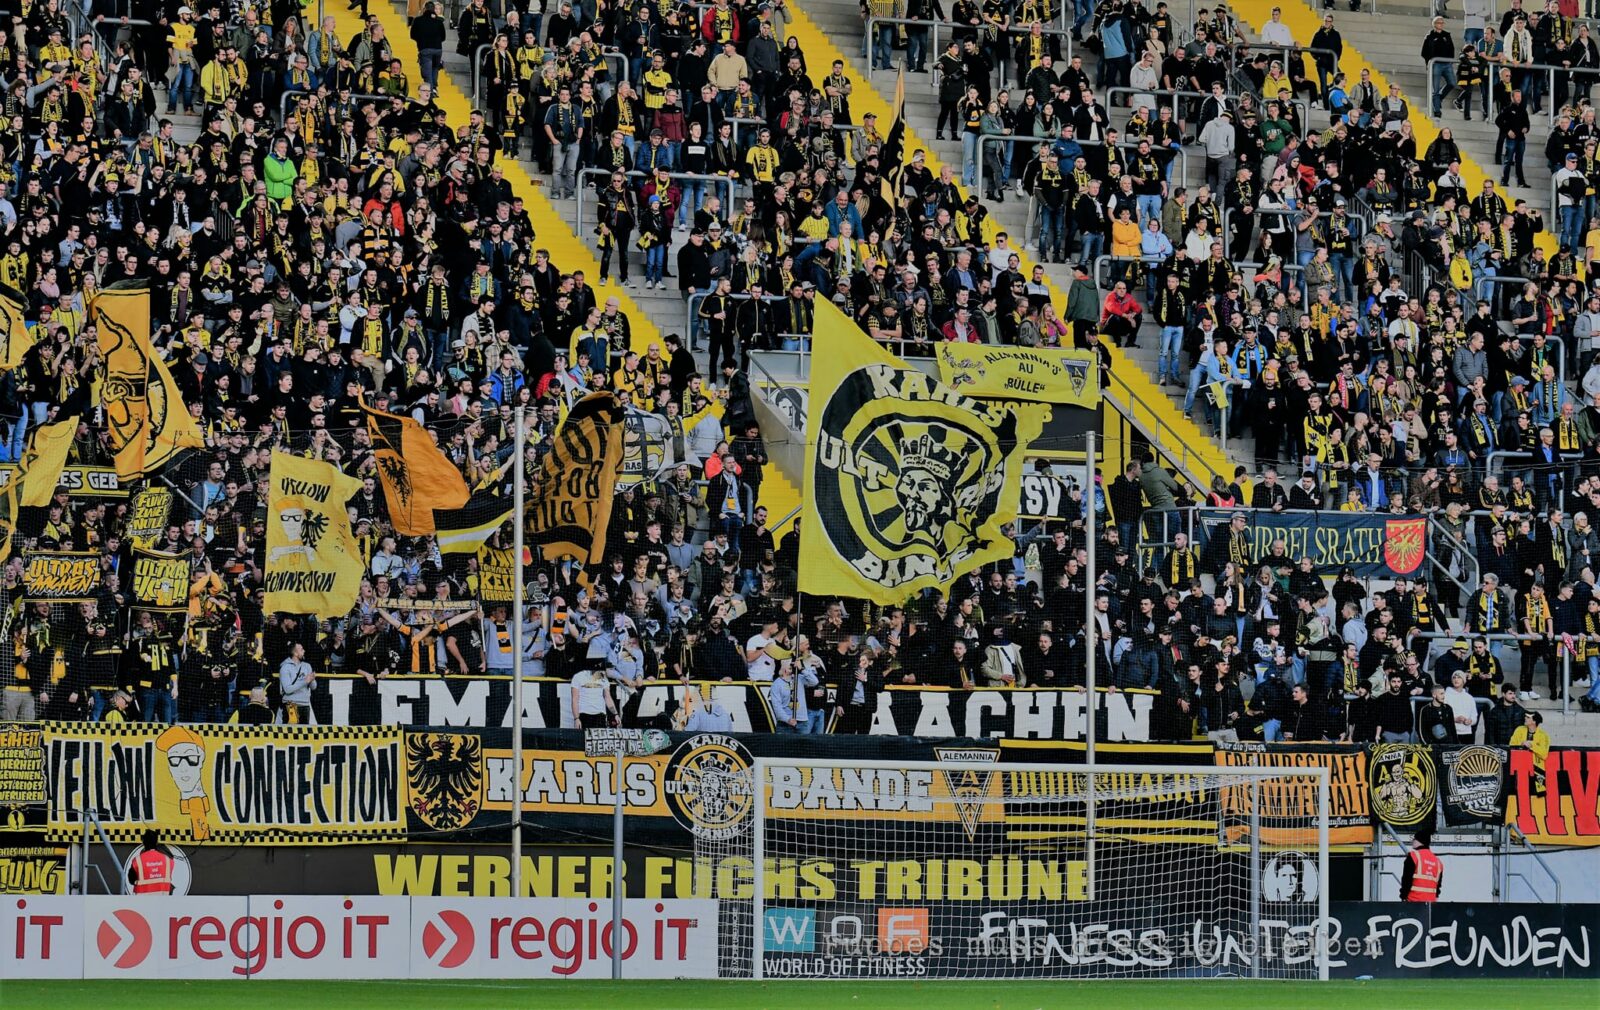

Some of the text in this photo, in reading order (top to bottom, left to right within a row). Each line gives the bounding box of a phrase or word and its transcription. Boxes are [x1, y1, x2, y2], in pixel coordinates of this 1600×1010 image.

[1019, 363, 1033, 374] AU
[281, 477, 331, 503] YELLOW
[688, 734, 741, 751] KARLS
[943, 752, 993, 761] ALEMANNIA
[214, 743, 400, 824] CONNECTION
[486, 757, 934, 812] KARLS BANDE
[373, 854, 1089, 901] WERNER FUCHS TRIBÜNE
[15, 899, 64, 960] iT
[168, 899, 390, 976] regio iT
[490, 902, 638, 976] regio
[654, 903, 699, 961] iT
[980, 911, 1591, 970] FITNESS UNTER FREUNDEN
[764, 957, 926, 976] WORLD OF FITNESS
